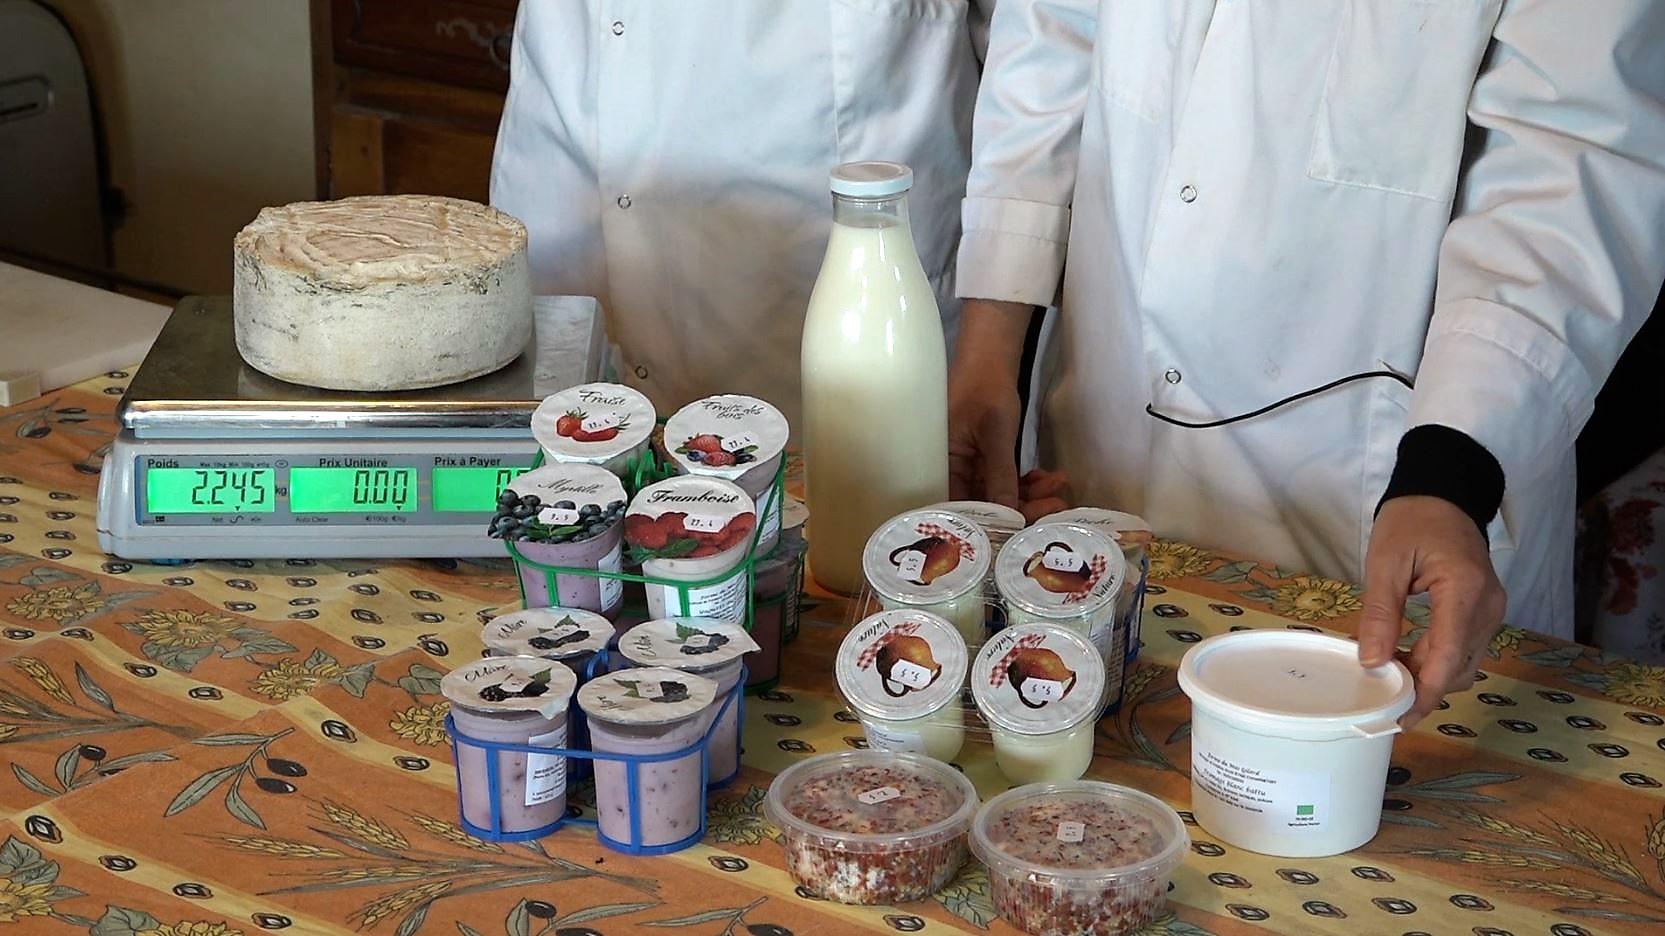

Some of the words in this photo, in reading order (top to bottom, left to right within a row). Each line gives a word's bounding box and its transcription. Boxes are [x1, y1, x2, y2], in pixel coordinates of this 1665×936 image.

[147, 459, 179, 468] Poids
[319, 458, 341, 468] Prix
[344, 458, 388, 468] Unitaire
[434, 456, 459, 466] Prix
[460, 456, 466, 466] à
[469, 456, 502, 468] Payer
[192, 470, 265, 505] 2.245
[275, 485, 287, 496] kg
[353, 470, 408, 504] 0.00
[647, 489, 740, 504] Framboise
